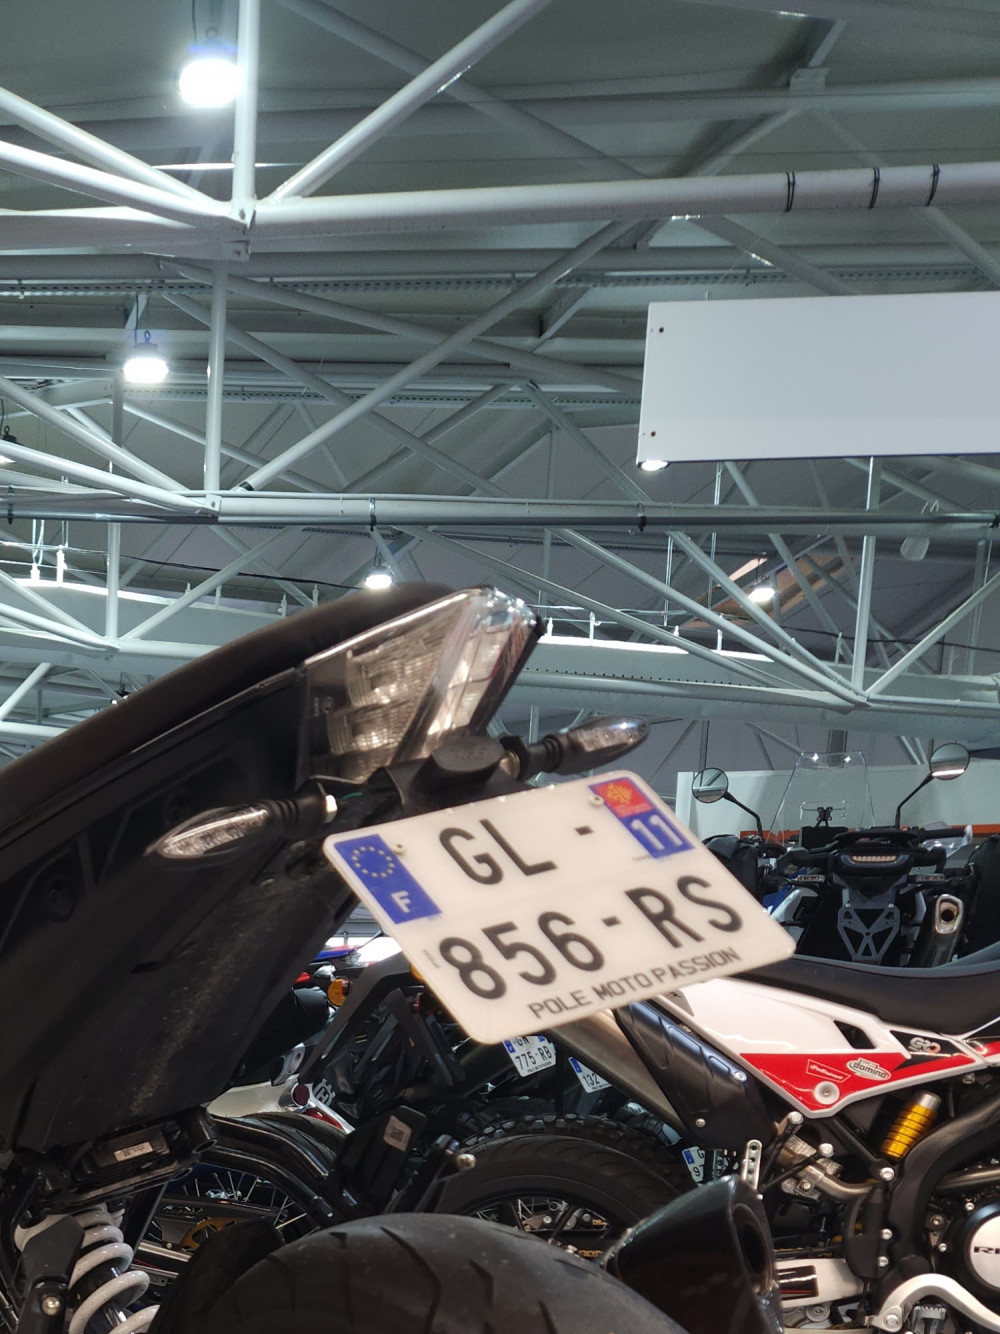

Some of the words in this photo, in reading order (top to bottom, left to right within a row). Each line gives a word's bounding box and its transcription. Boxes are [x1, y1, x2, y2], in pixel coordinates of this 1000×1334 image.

[438, 818, 559, 886] GL
[631, 814, 683, 851] 11
[390, 891, 412, 913] F
[528, 990, 593, 1019] POLE
[591, 974, 651, 1001] MOTO
[648, 947, 743, 984] PASSION
